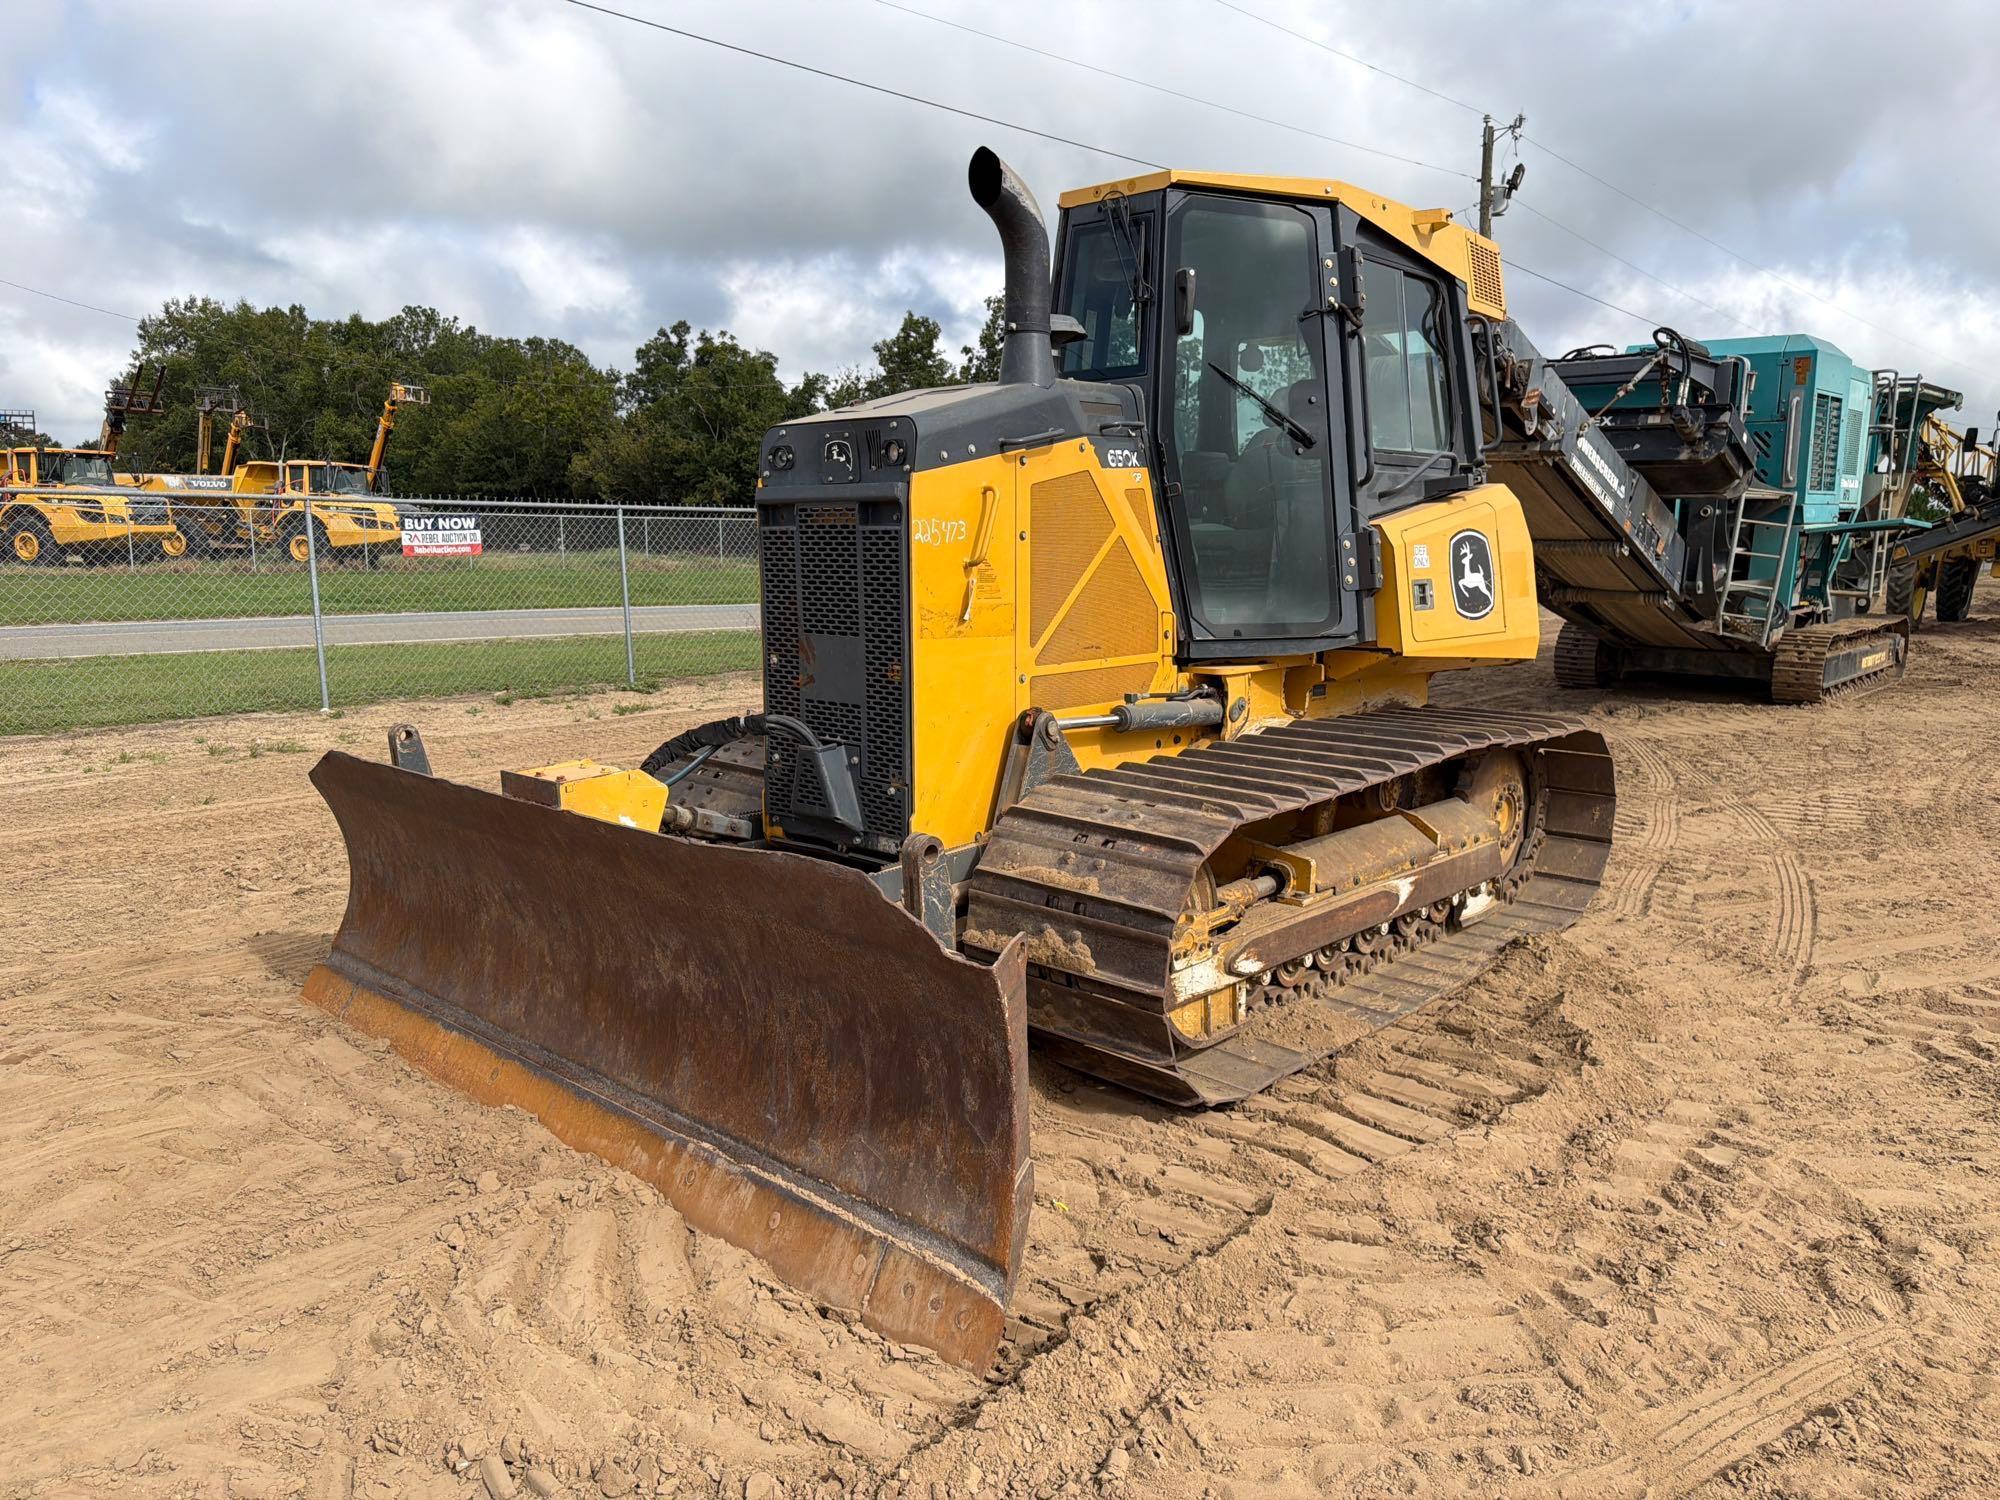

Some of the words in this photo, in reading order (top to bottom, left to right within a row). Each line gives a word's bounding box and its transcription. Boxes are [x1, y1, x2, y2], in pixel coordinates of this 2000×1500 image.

[1107, 449, 1140, 467] 650K
[1577, 437, 1619, 491] OWERSCREEN
[191, 480, 227, 488] VOLVO
[404, 518, 434, 530] BUY
[438, 517, 476, 530] NOW
[421, 533, 440, 543] REBEL
[441, 533, 468, 543] AUCTION
[912, 518, 967, 546] 225473
[413, 546, 472, 554] RebelAuction.com
